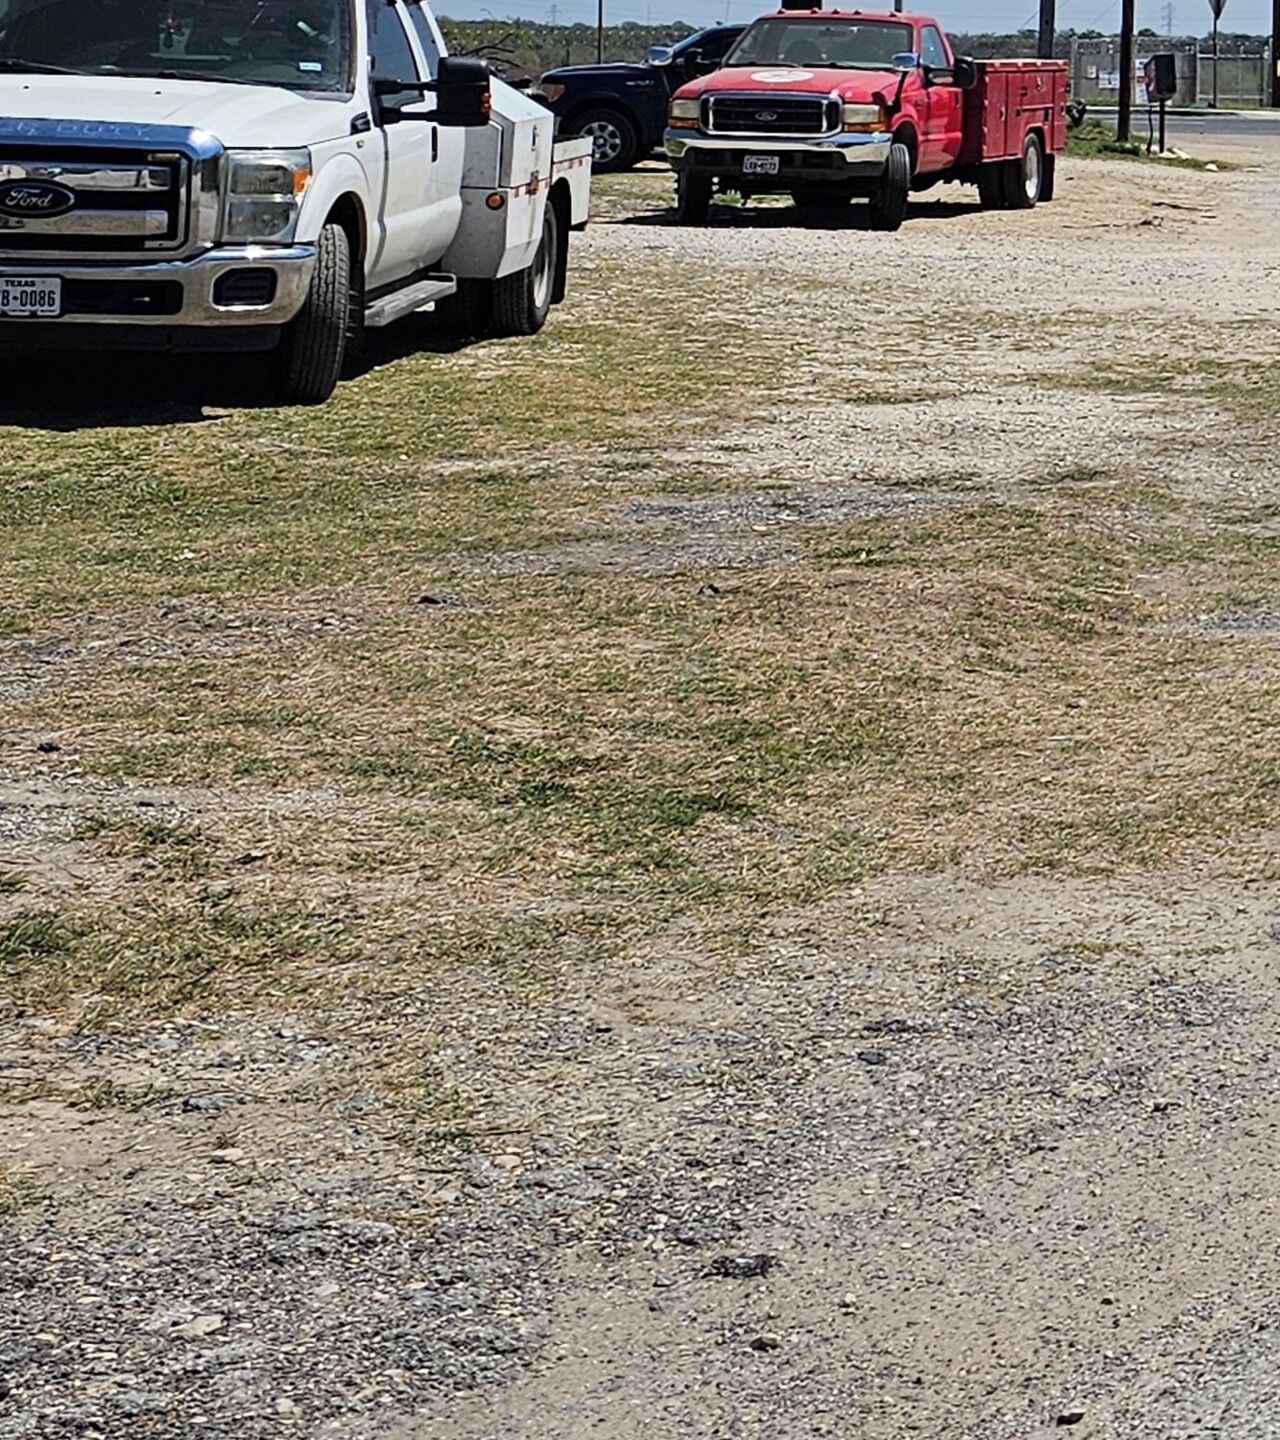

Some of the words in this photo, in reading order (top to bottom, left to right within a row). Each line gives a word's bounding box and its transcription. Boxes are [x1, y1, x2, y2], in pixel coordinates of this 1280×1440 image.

[5, 187, 53, 208] Ford
[4, 279, 36, 288] TEXAS
[0, 289, 56, 308] B-0086
